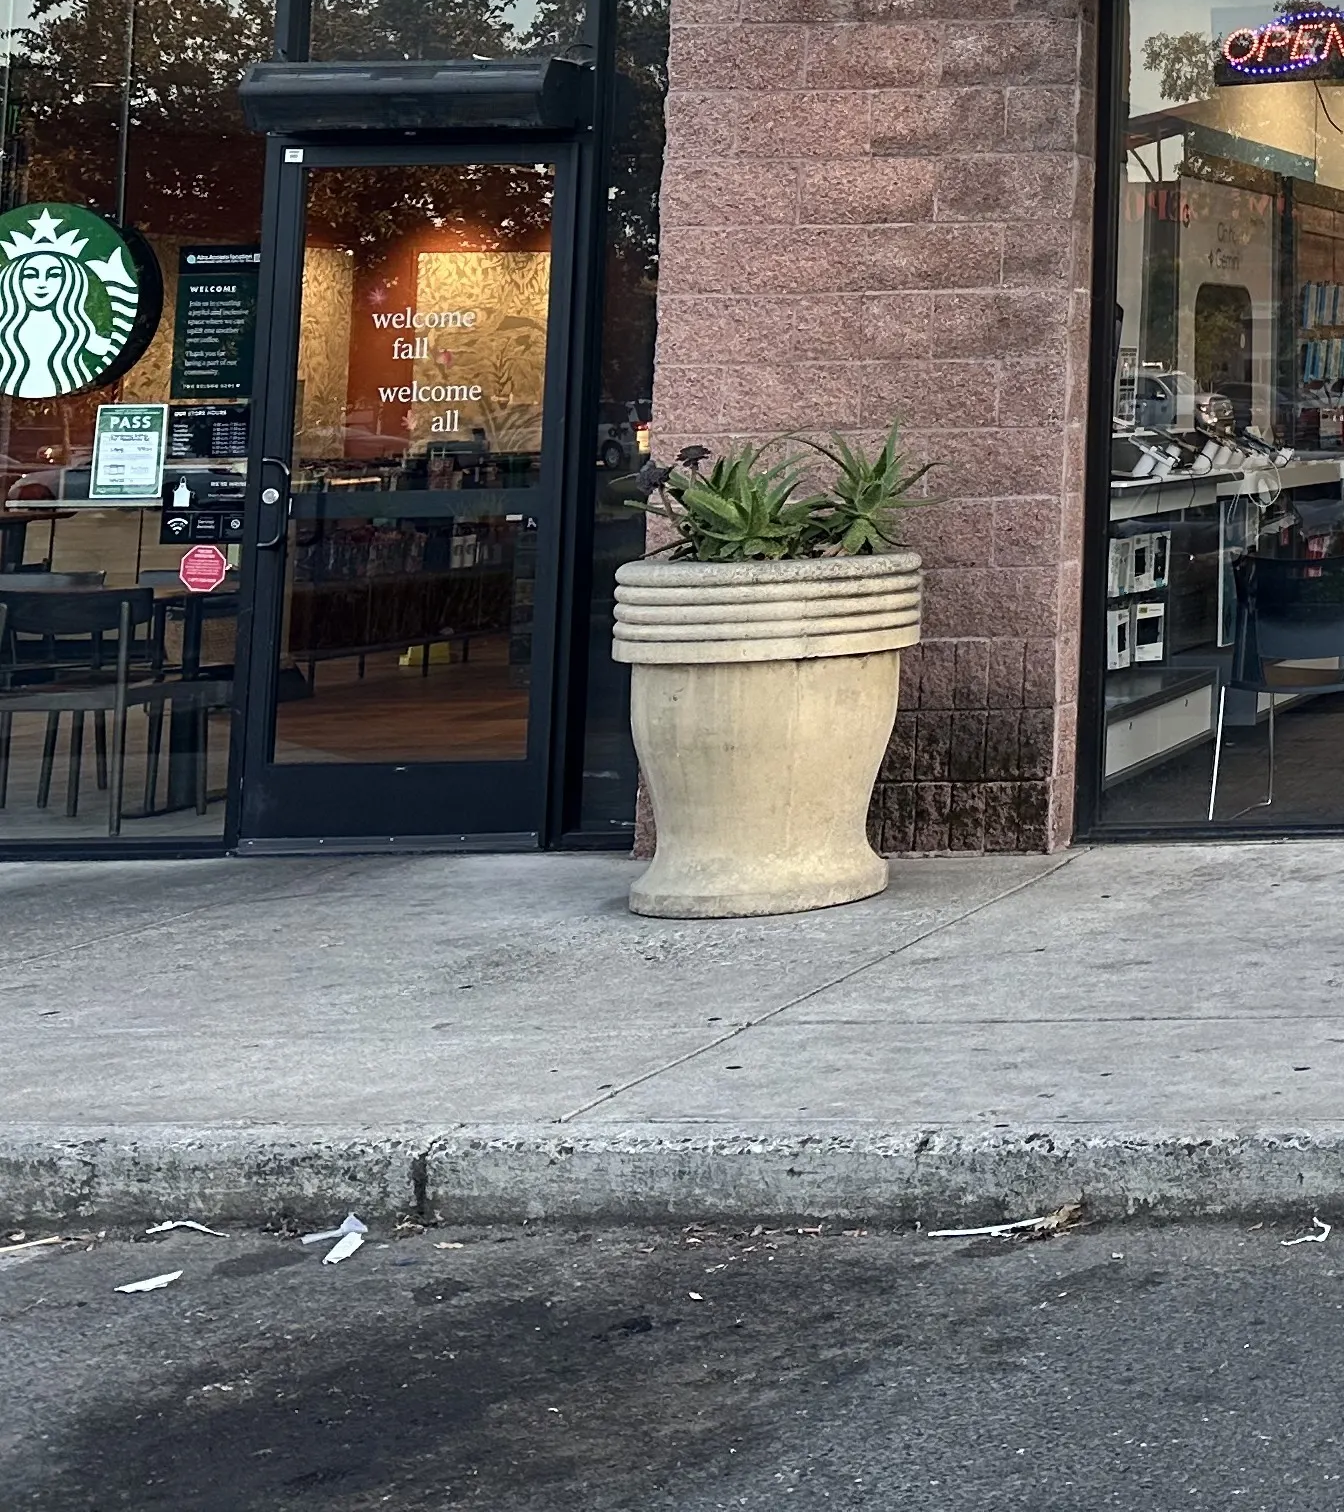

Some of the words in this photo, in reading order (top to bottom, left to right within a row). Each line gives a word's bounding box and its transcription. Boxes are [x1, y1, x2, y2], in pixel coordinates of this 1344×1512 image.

[189, 285, 237, 293] WELCOME
[371, 306, 477, 329] welcome
[392, 337, 430, 360] fall
[378, 380, 483, 403] welcome
[110, 416, 152, 429] PASS
[431, 409, 459, 432] all
